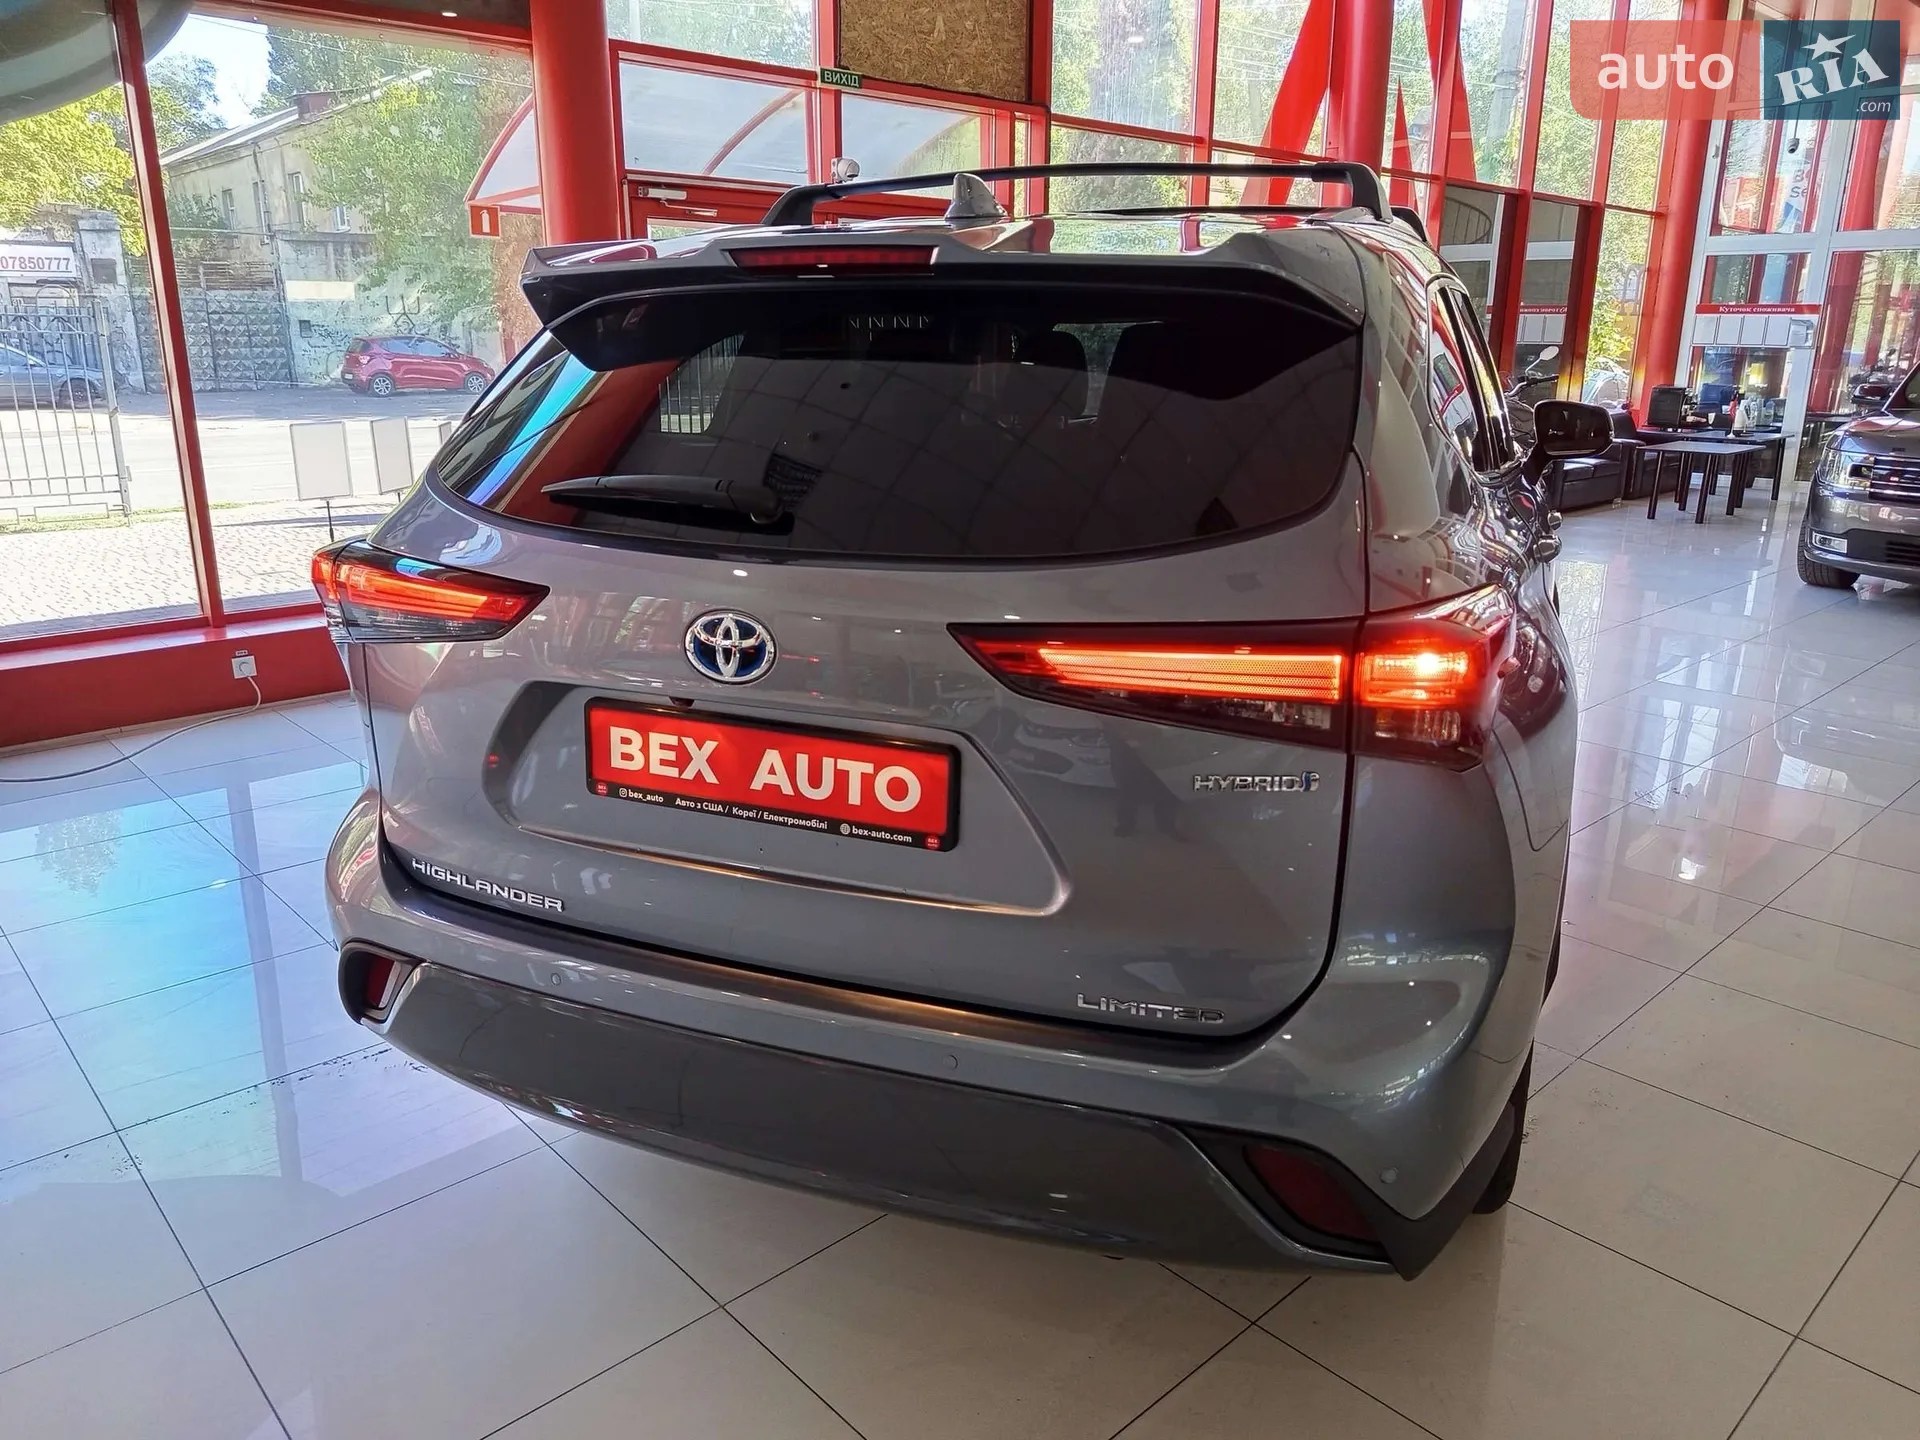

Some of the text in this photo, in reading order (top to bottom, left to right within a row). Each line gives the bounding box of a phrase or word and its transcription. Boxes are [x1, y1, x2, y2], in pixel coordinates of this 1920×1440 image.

[824, 70, 860, 88] ВИХІД
[0, 256, 71, 270] 07850777
[1719, 306, 1752, 314] Куточок
[609, 725, 922, 813] BEX AUTO
[1193, 775, 1301, 792] HYBRID
[628, 789, 664, 803] bex_auto
[675, 798, 695, 809] Авто
[703, 802, 724, 814] США
[732, 806, 757, 818] Кореї
[763, 811, 828, 830] Електромобілі
[852, 825, 912, 843] bex-auto.com
[412, 857, 564, 913] HIGHLANDER
[1077, 993, 1225, 1024] LIMITED
